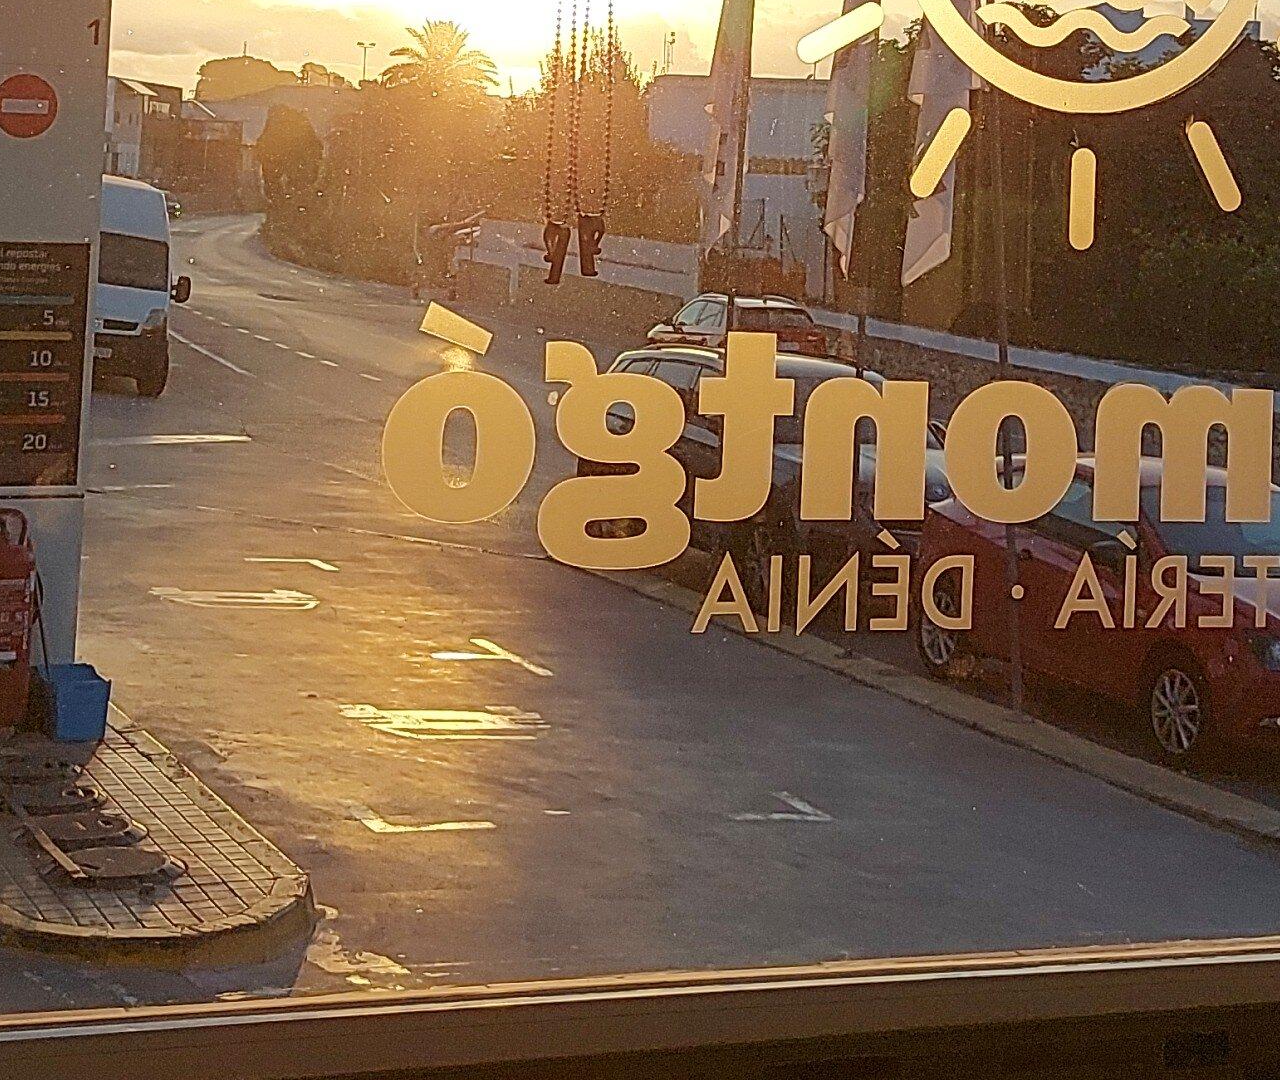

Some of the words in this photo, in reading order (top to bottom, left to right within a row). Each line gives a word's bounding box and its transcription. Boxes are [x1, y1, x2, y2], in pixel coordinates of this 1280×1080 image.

[87, 19, 101, 45] 1
[42, 310, 54, 325] 5
[30, 350, 52, 366] 10
[28, 391, 49, 407] 15
[22, 434, 47, 451] 20
